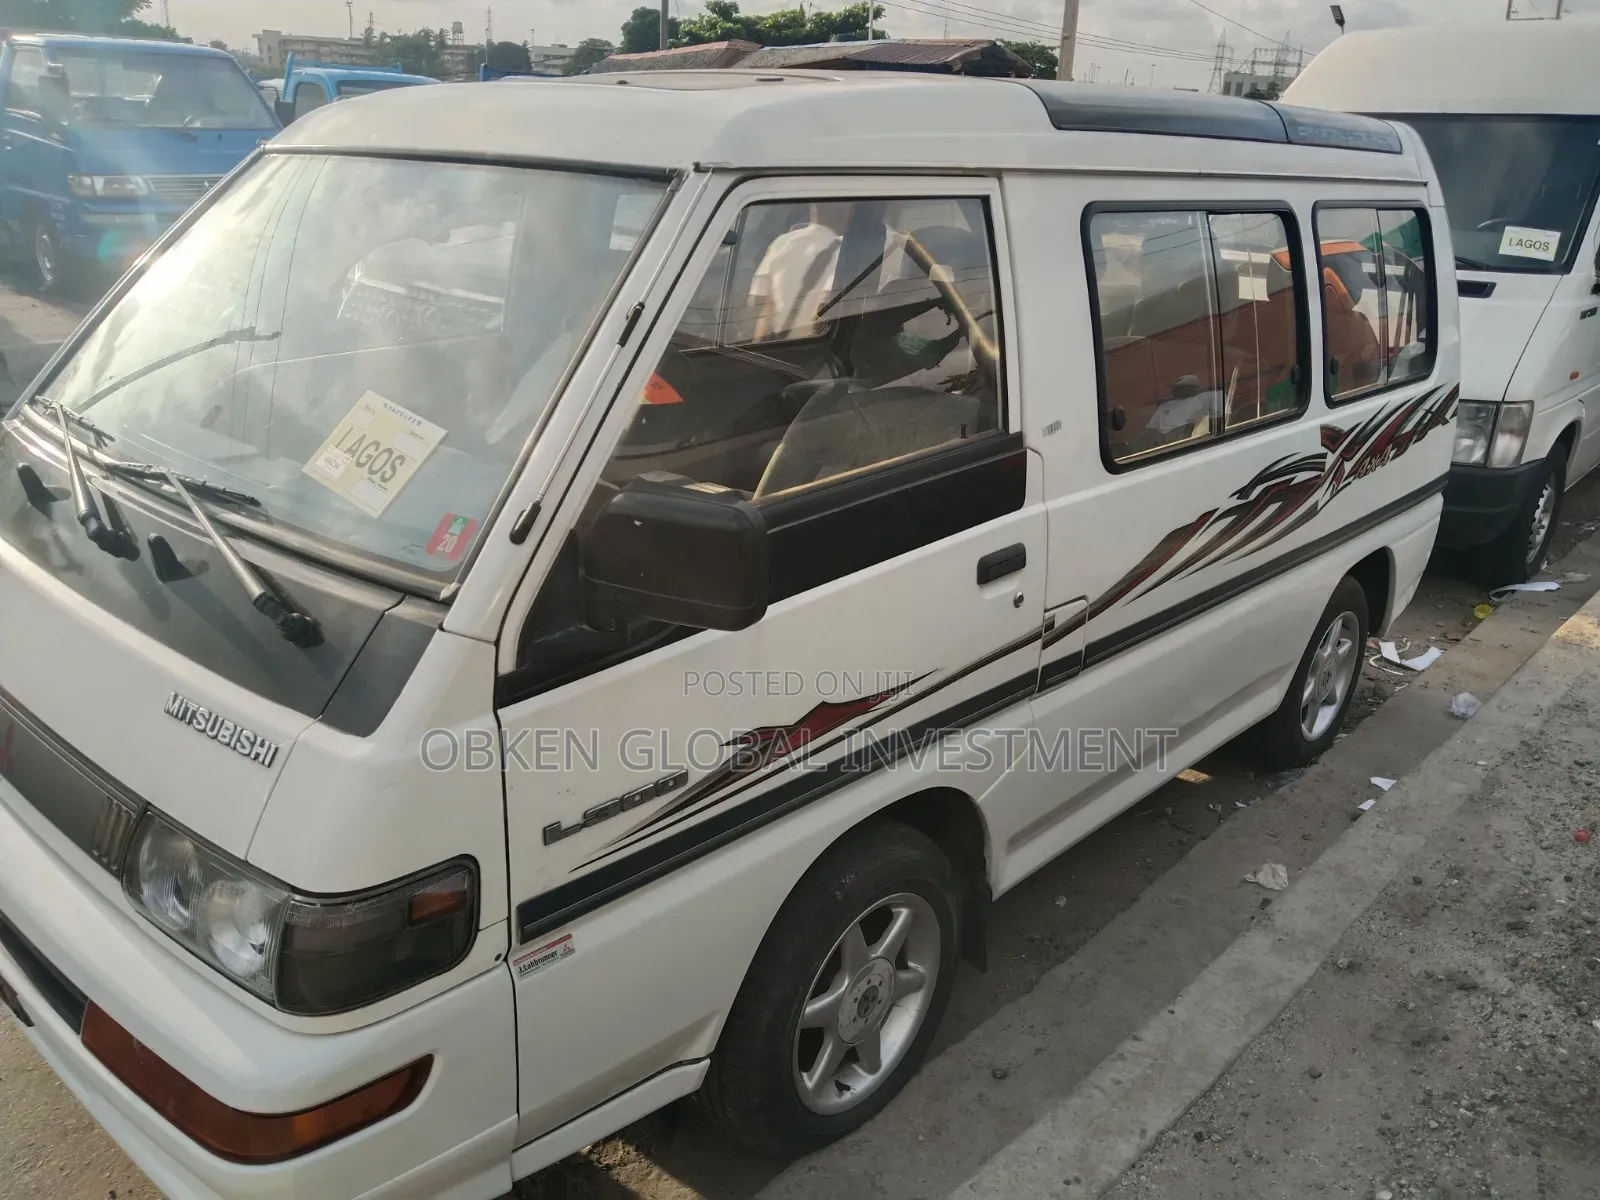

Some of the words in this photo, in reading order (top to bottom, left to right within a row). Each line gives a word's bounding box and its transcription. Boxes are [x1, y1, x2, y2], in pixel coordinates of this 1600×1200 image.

[1508, 237, 1550, 252] LAGOS
[436, 533, 459, 553] 20
[164, 691, 278, 768] MITSUBISHI
[542, 768, 689, 846] L300
